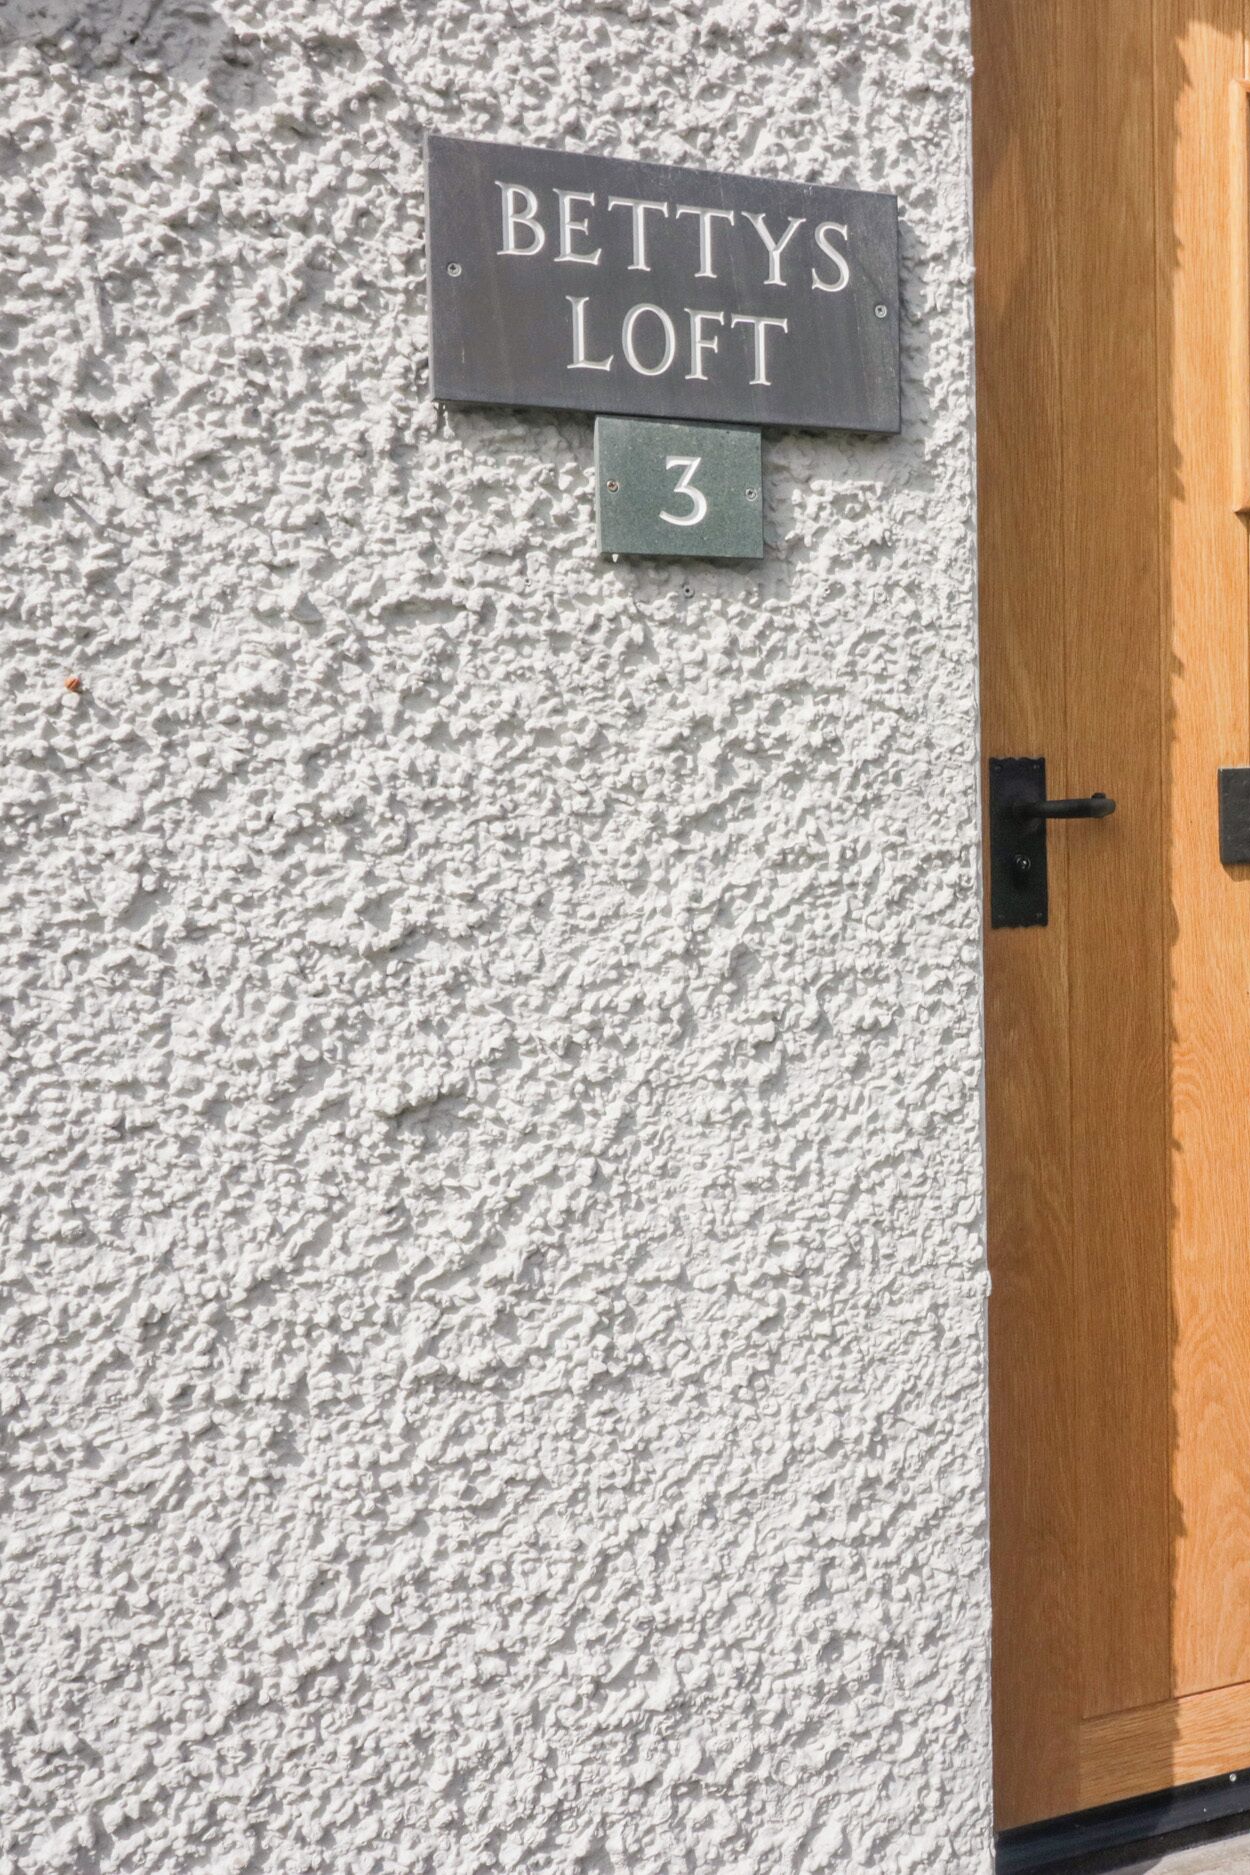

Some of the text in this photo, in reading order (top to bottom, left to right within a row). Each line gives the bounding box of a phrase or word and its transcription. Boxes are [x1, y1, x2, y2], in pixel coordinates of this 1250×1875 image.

[495, 181, 850, 292] BETTYS
[566, 296, 788, 385] LOFT
[659, 455, 707, 526] 3
